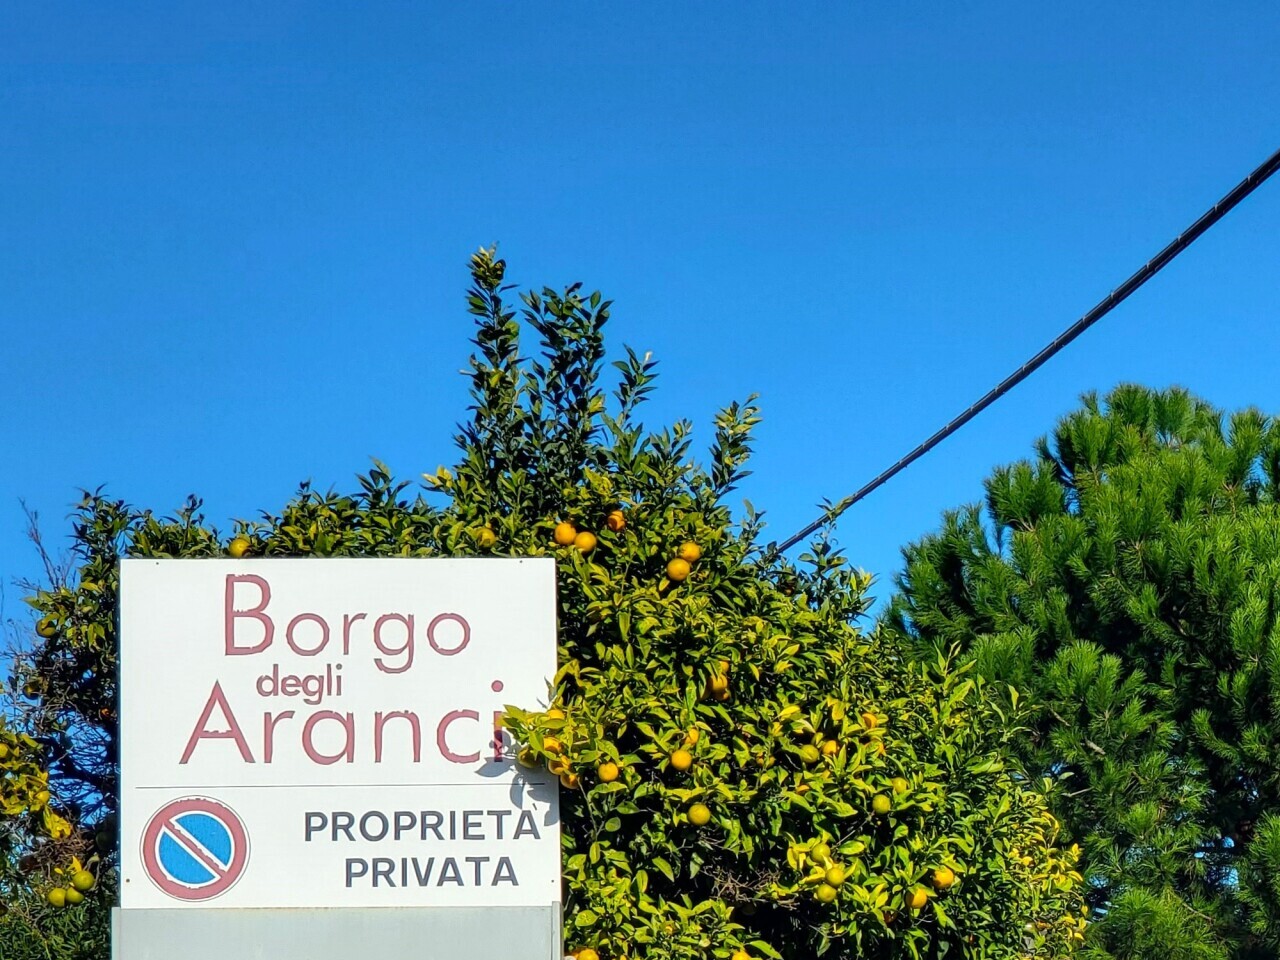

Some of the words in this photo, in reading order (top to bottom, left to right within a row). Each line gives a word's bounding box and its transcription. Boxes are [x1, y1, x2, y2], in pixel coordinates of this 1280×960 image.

[224, 573, 471, 674] Borgo
[256, 663, 342, 705] degli
[179, 679, 505, 765] Aranci
[344, 856, 519, 888] PRIVATA
